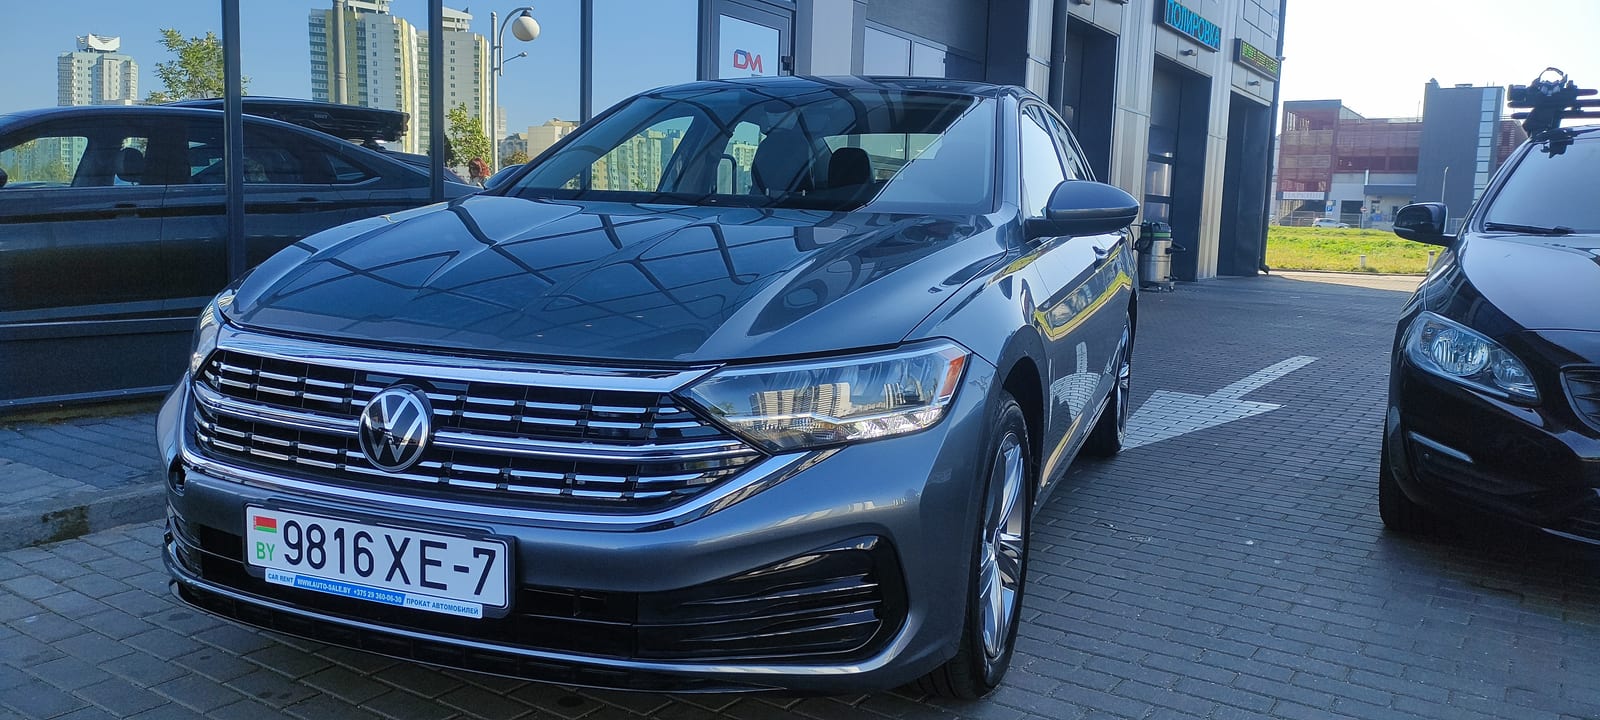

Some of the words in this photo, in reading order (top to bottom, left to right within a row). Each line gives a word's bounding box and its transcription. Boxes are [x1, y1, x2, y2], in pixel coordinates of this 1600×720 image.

[1166, 0, 1220, 48] ПОЛИРОВКА
[733, 49, 763, 73] DM
[256, 541, 275, 561] BY
[283, 519, 374, 578] 9816
[385, 534, 496, 596] XE-7
[267, 573, 279, 581] CAR
[279, 575, 294, 584] RENT
[297, 578, 351, 594] WWW.AUTO-SALE.BY
[353, 588, 367, 598] +375
[406, 598, 431, 608] ПРОКАТ
[431, 602, 478, 615] АВТОМОБИЛЕЙ
